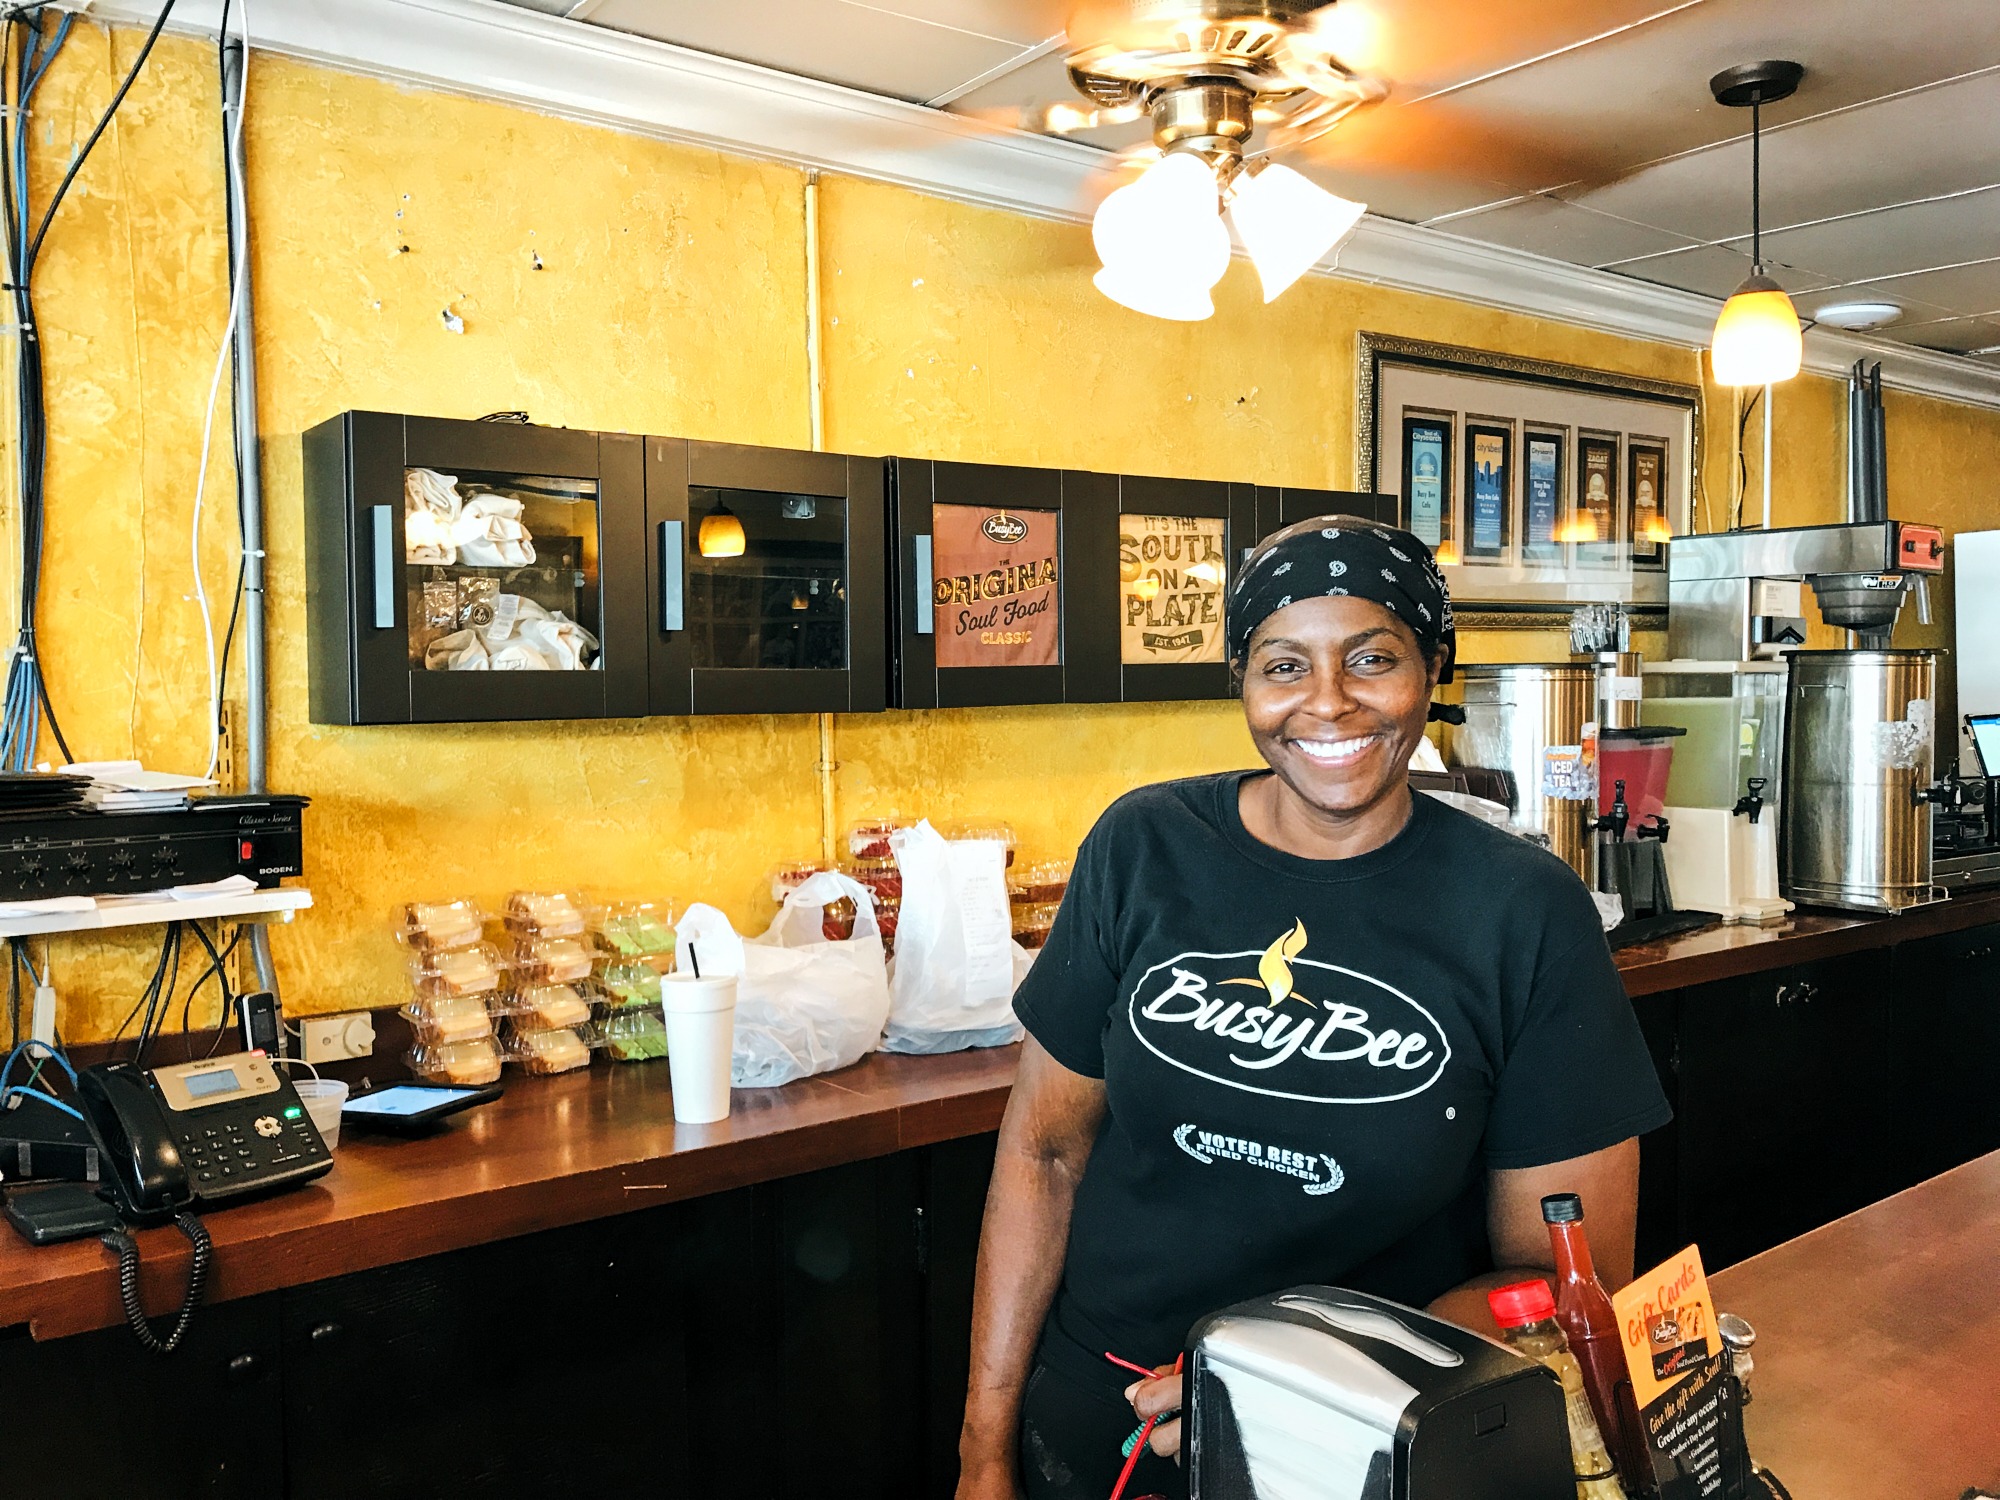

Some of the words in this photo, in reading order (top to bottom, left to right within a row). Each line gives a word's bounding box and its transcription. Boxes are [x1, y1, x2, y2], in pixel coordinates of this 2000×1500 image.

[1144, 516, 1170, 531] IT'S
[1173, 517, 1198, 531] THE
[934, 557, 1058, 607] ORIGINA
[1146, 568, 1178, 590] ON
[956, 605, 999, 636] Soul
[1003, 590, 1050, 626] Food
[1126, 592, 1218, 627] PLATE
[980, 630, 1033, 646] CLASSIC
[1154, 637, 1171, 647] EST.
[1171, 634, 1192, 647] 1947
[1551, 760, 1573, 774] ICED
[1553, 774, 1572, 788] TEA
[272, 812, 292, 823] Series
[259, 865, 294, 875] BOGEN
[1196, 1143, 1242, 1161] FRIED
[1246, 1156, 1320, 1183] CHICKEN
[1198, 1130, 1262, 1158] VOTED
[1267, 1145, 1318, 1172] BEST
[1628, 1302, 1655, 1347] Gift
[1657, 1263, 1697, 1312] Cards
[1656, 1368, 1664, 1376] The
[1663, 1346, 1686, 1376] Original
[1650, 1413, 1665, 1434] Give
[1664, 1402, 1677, 1420] the
[1676, 1388, 1689, 1418] gift
[1689, 1373, 1705, 1397] with
[1704, 1354, 1722, 1383] Soul!
[1657, 1427, 1677, 1449] Great
[1675, 1421, 1687, 1435] for
[1686, 1412, 1698, 1426] any
[1670, 1438, 1691, 1457] Mother's
[1688, 1433, 1699, 1444] Day
[1690, 1436, 1715, 1459] Graduation
